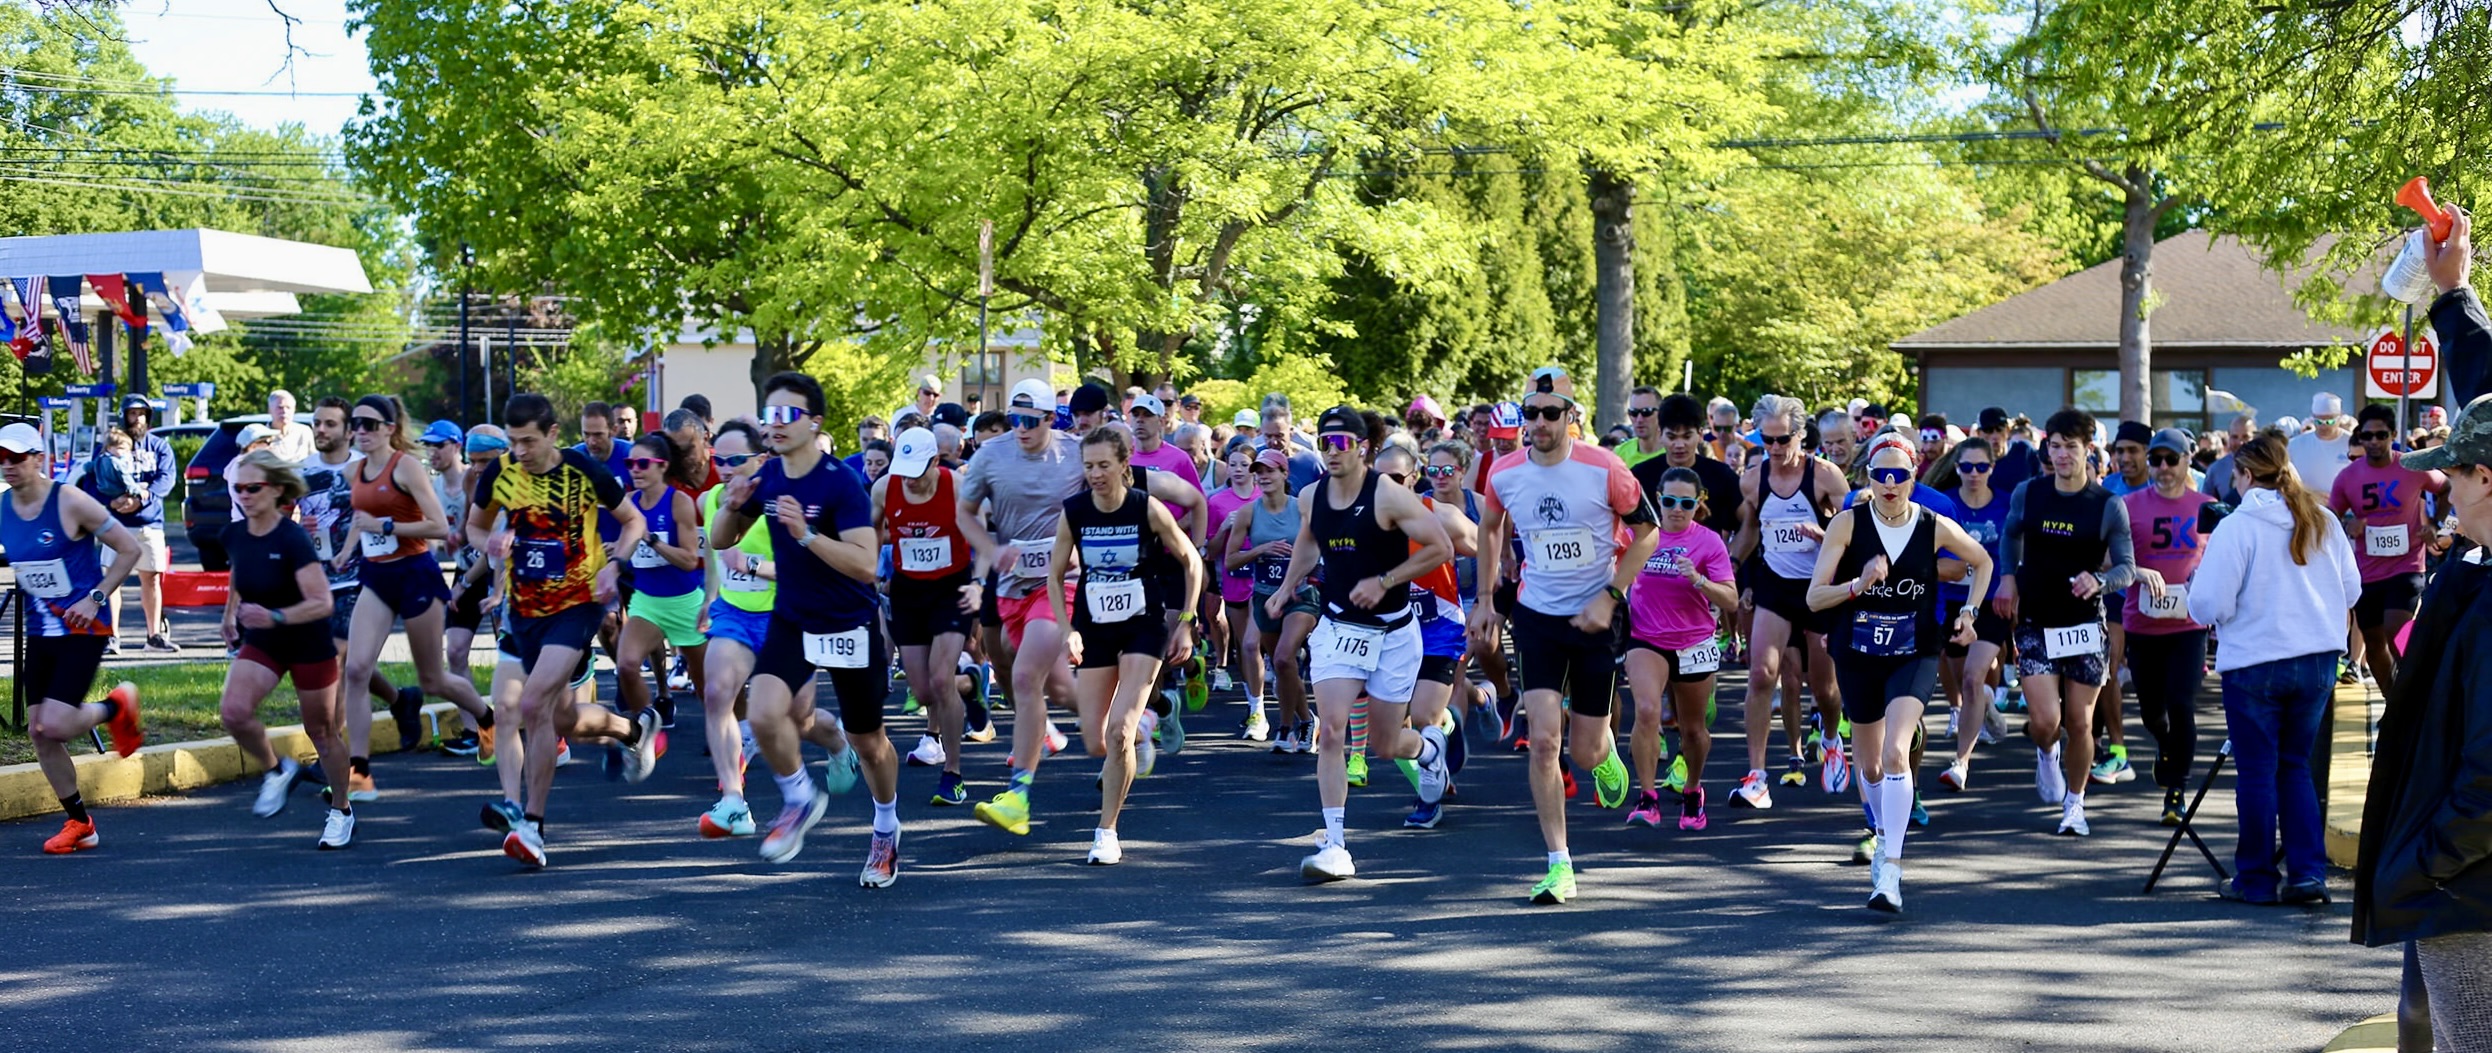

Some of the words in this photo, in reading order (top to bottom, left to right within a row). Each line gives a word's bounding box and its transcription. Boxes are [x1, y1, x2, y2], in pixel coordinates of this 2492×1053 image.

[2379, 341, 2397, 353] DO
[2382, 372, 2421, 384] ENTER
[2362, 480, 2401, 511] 5K
[914, 528, 924, 537] P
[1085, 526, 1114, 535] STAND
[1115, 525, 1138, 534] WITH
[2042, 520, 2074, 532] HYPR
[2150, 516, 2197, 550] 5K
[1545, 542, 1582, 561] 1293
[2375, 536, 2401, 549] 1395
[527, 551, 545, 569] 26
[912, 547, 941, 563] 1337
[1268, 565, 1282, 578] 32
[1896, 578, 1925, 600] Ops
[1099, 593, 1131, 612] 1287
[1873, 626, 1894, 645] 57
[2058, 629, 2089, 646] 1178
[819, 637, 855, 655] 1199
[1335, 636, 1369, 657] 1175
[1691, 646, 1719, 664] 1319
